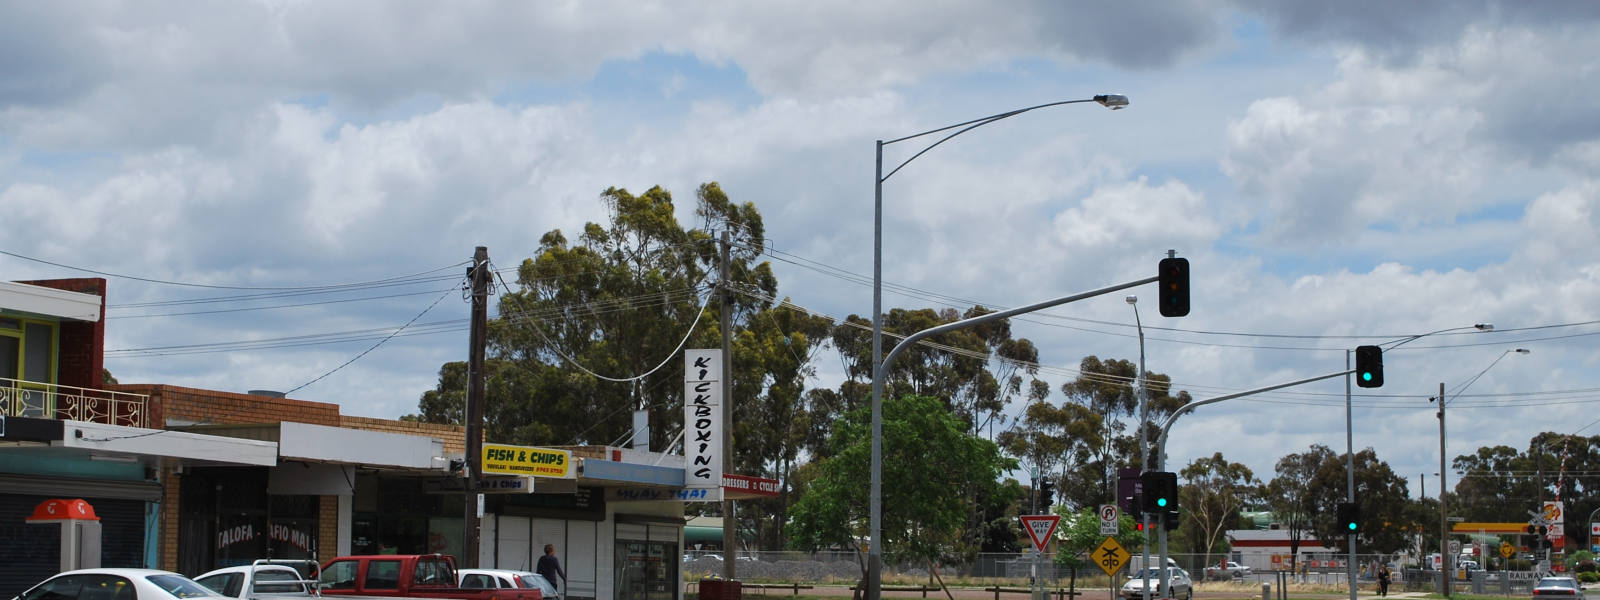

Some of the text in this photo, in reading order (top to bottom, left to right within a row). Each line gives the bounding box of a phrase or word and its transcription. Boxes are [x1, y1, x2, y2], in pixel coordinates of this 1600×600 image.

[694, 356, 711, 479] KICKBOXING
[487, 449, 564, 466] FISH & CHIPS
[722, 477, 749, 489] DRESSERS
[759, 481, 774, 492] CYCLE
[617, 488, 708, 500] MUAY THAI
[218, 524, 253, 549] TALOFA
[291, 530, 310, 552] MAI
[1509, 572, 1545, 580] RAILWAY
